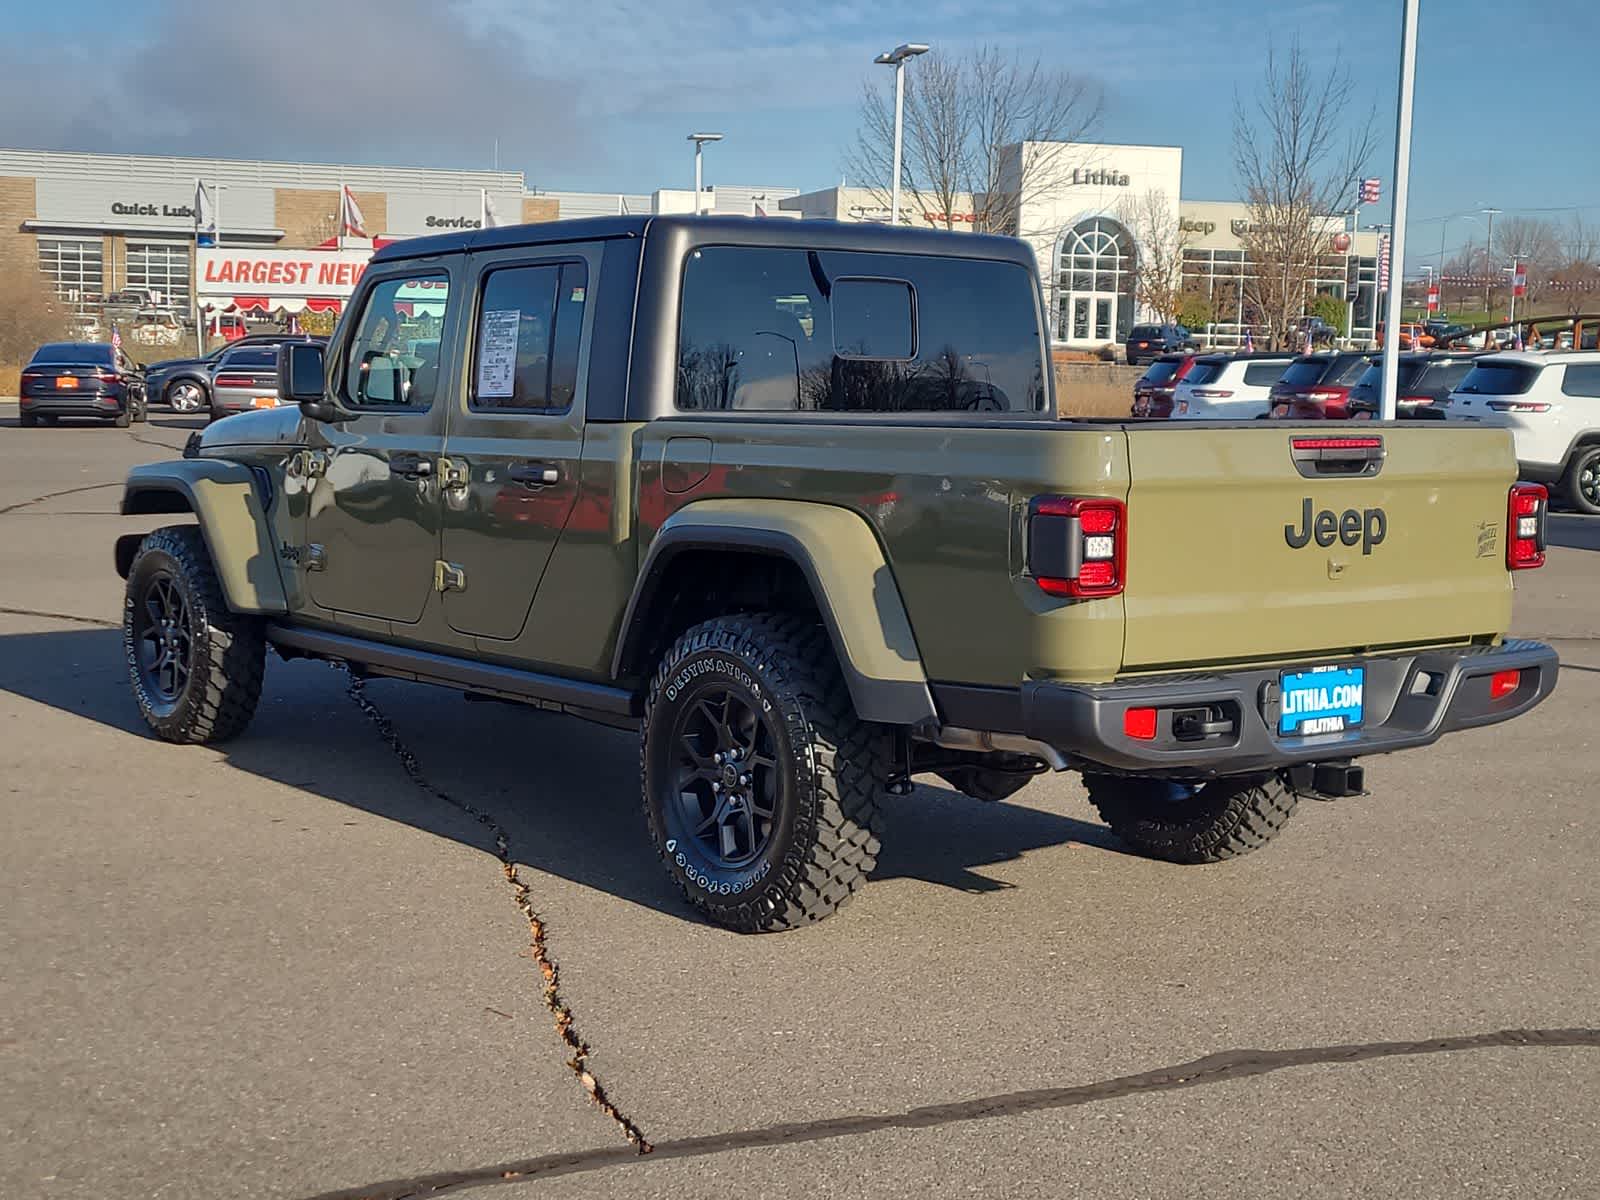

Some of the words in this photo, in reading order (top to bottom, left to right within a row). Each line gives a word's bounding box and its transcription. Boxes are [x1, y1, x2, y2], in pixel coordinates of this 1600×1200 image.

[1073, 168, 1129, 186] Lithia
[112, 202, 158, 216] Quick
[425, 215, 481, 229] Service
[205, 260, 312, 285] LARGEST
[1285, 497, 1387, 555] Jeep
[665, 657, 762, 702] DESTINATION
[1282, 684, 1363, 714] LITHIA.COM
[675, 852, 772, 896] Firestone
